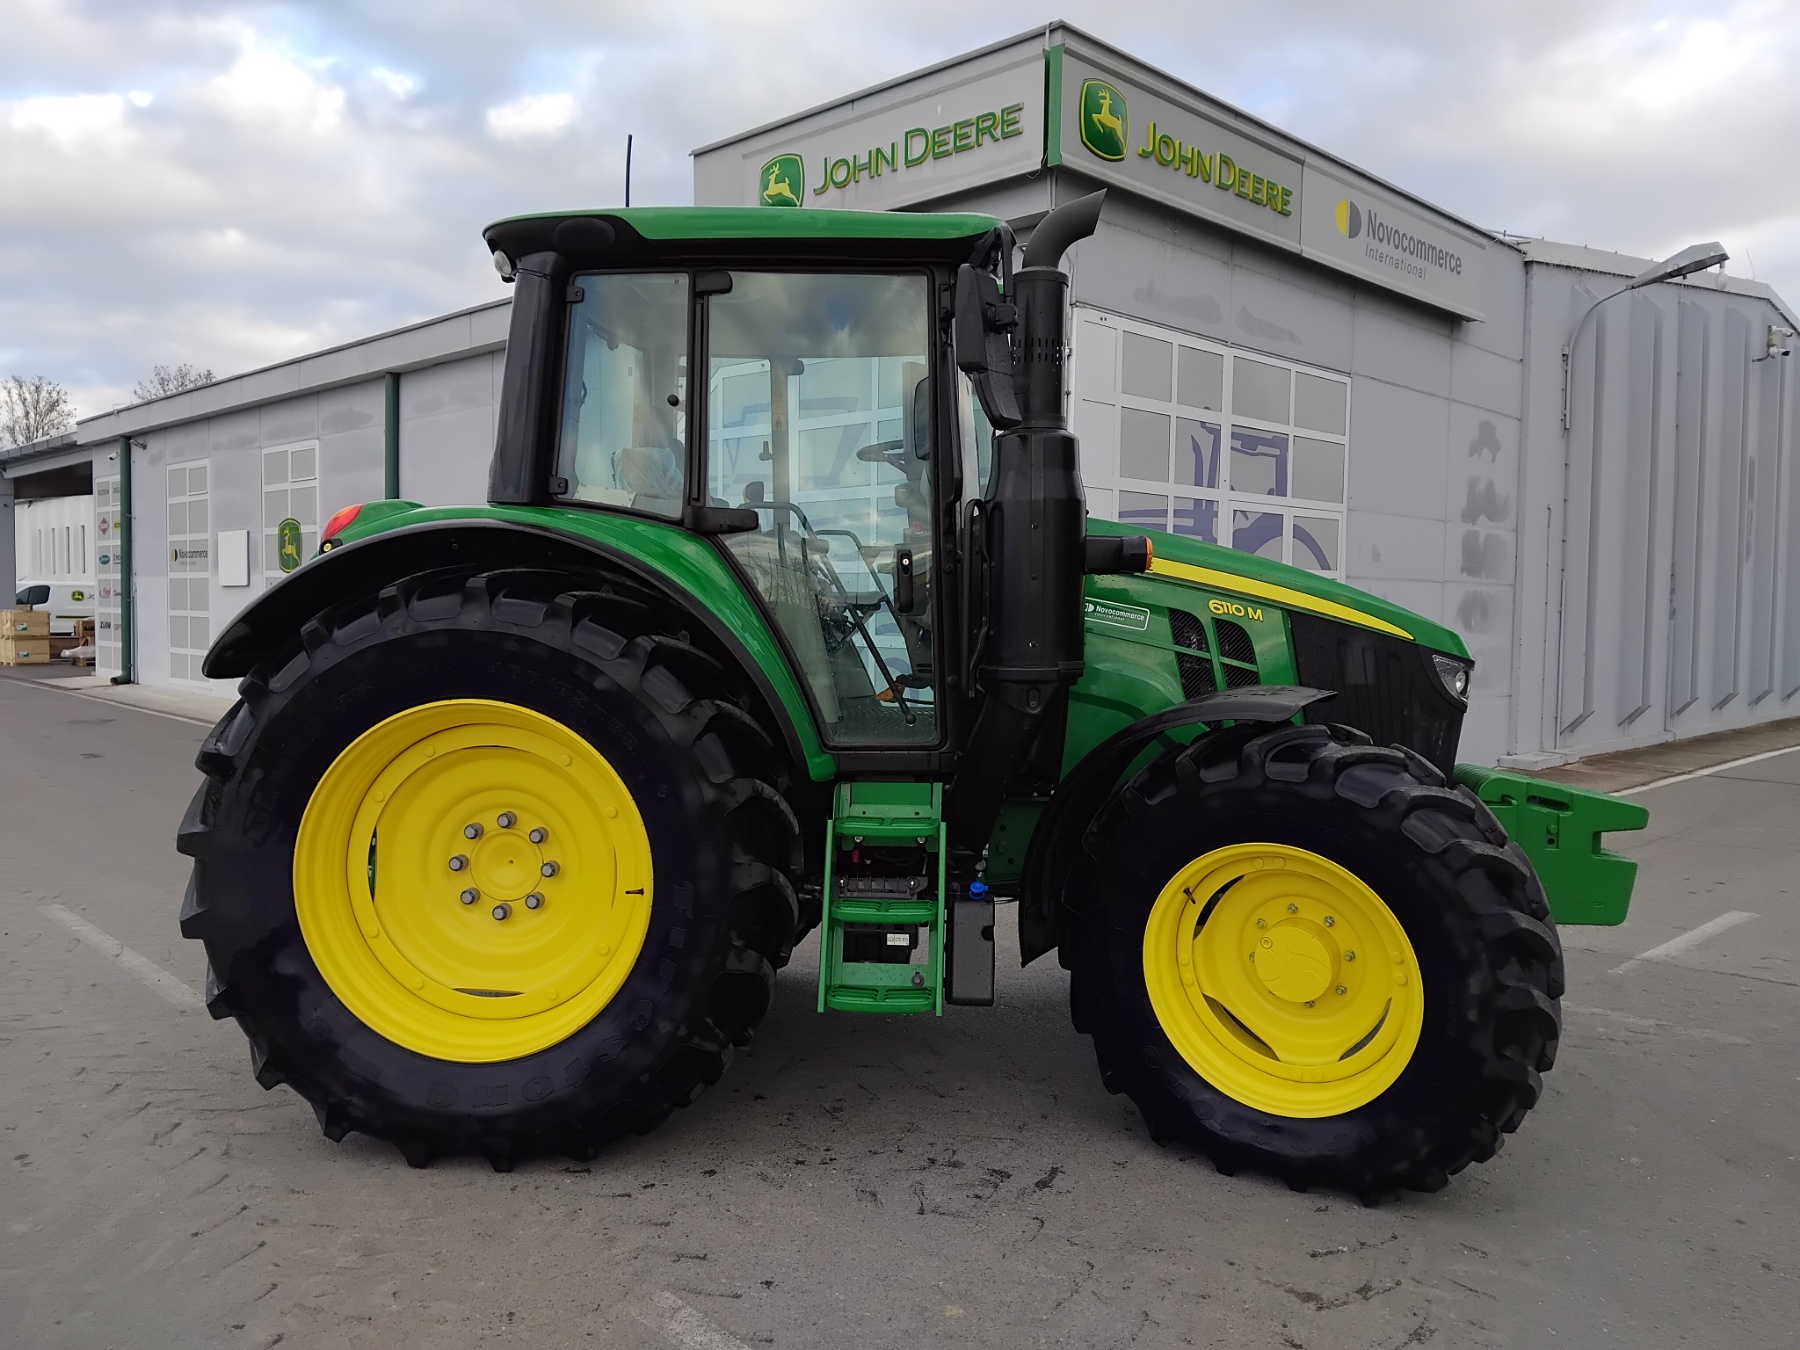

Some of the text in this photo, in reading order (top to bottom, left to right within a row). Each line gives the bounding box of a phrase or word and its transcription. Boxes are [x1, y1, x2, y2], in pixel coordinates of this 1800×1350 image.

[813, 101, 1025, 195] JOHN DEERE
[1138, 121, 1293, 217] JOHN DEERE
[1365, 243, 1427, 280] International
[1366, 209, 1462, 275] Novocommerce
[1095, 603, 1145, 621] Novocommerce
